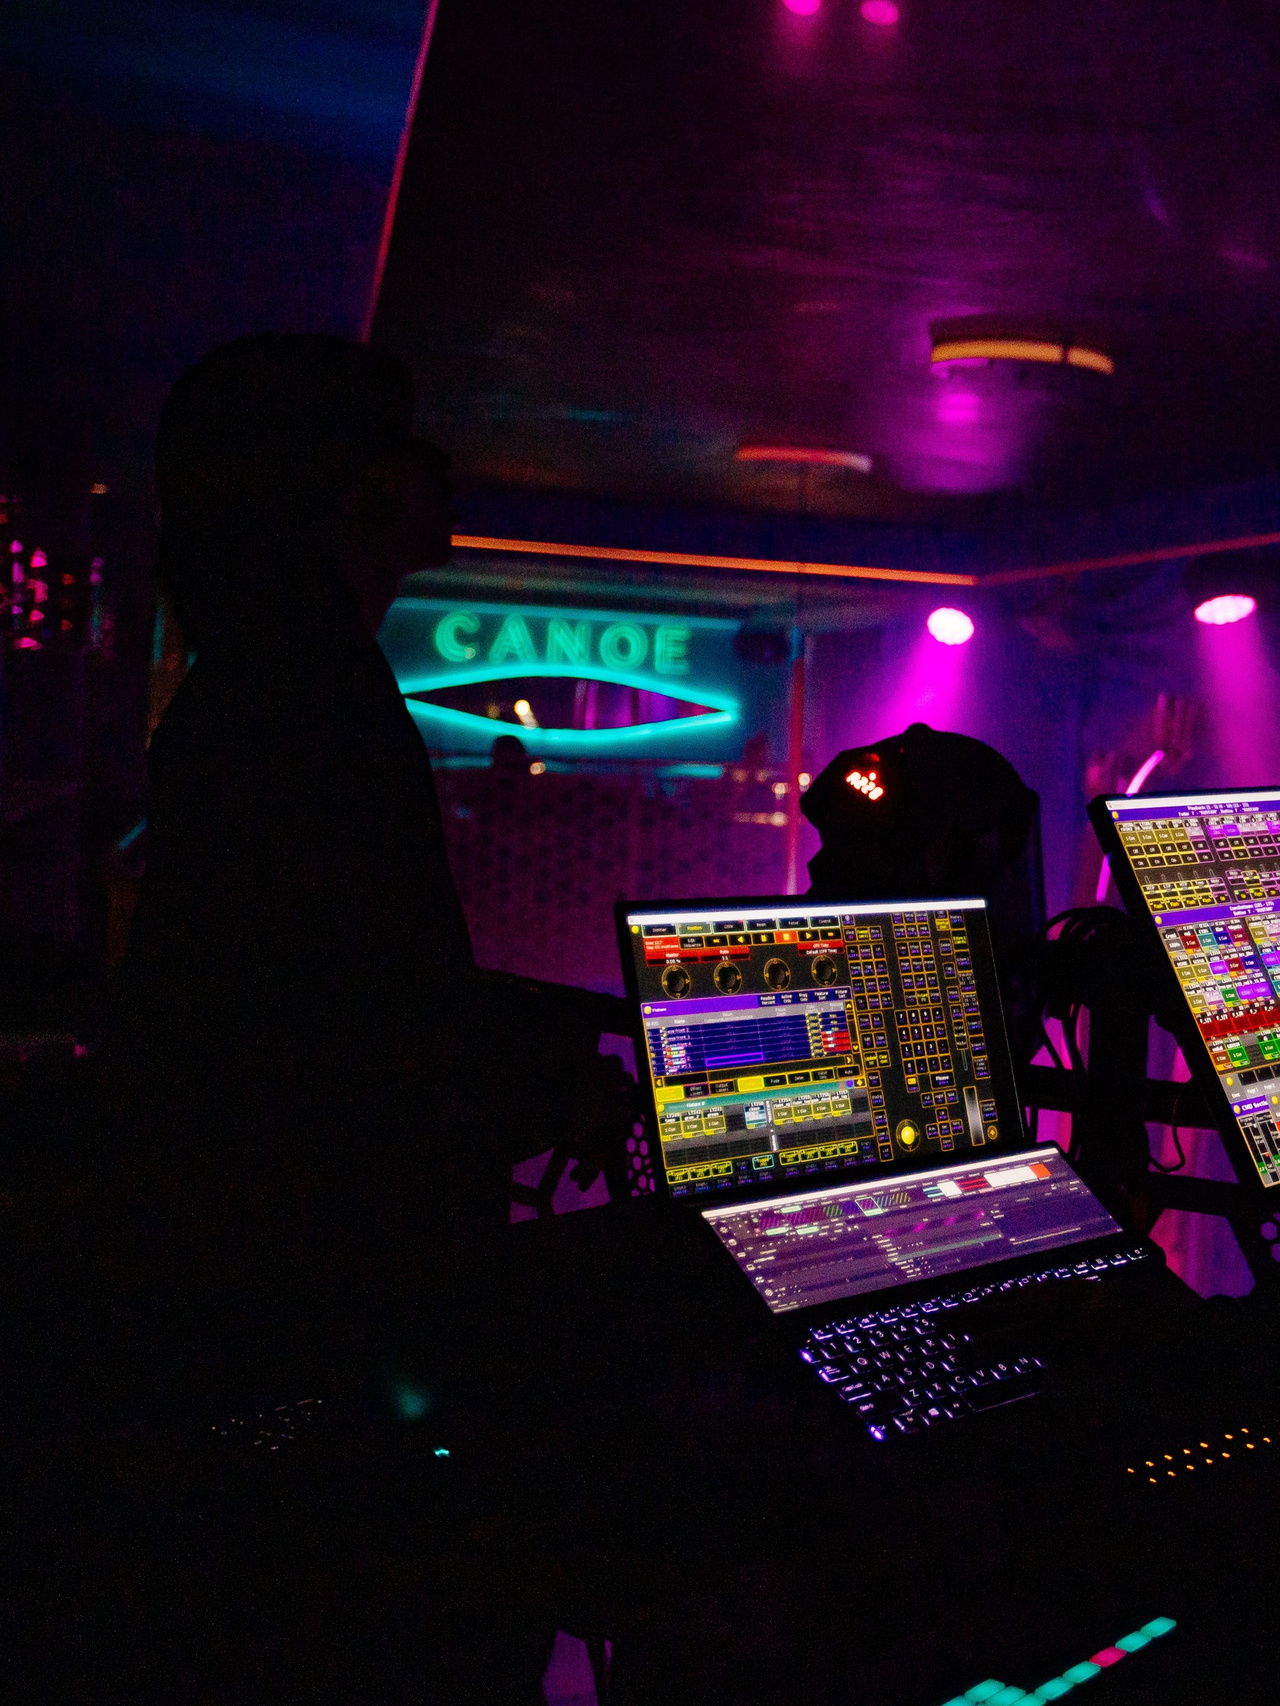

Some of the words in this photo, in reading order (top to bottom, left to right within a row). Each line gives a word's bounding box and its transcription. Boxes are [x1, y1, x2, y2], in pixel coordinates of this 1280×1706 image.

[433, 609, 693, 675] CANOE
[876, 1330, 884, 1338] 3
[852, 1336, 862, 1344] 2
[925, 1339, 935, 1347] R
[903, 1344, 912, 1353] E
[878, 1351, 891, 1360] W
[856, 1357, 868, 1366] Q
[925, 1361, 935, 1369] D
[1018, 1356, 1029, 1365] N
[903, 1367, 913, 1375] S
[997, 1363, 1007, 1371] B
[881, 1374, 890, 1382] A
[975, 1369, 985, 1378] V
[954, 1375, 965, 1384] C
[932, 1382, 942, 1391] X
[908, 1388, 919, 1397] Z
